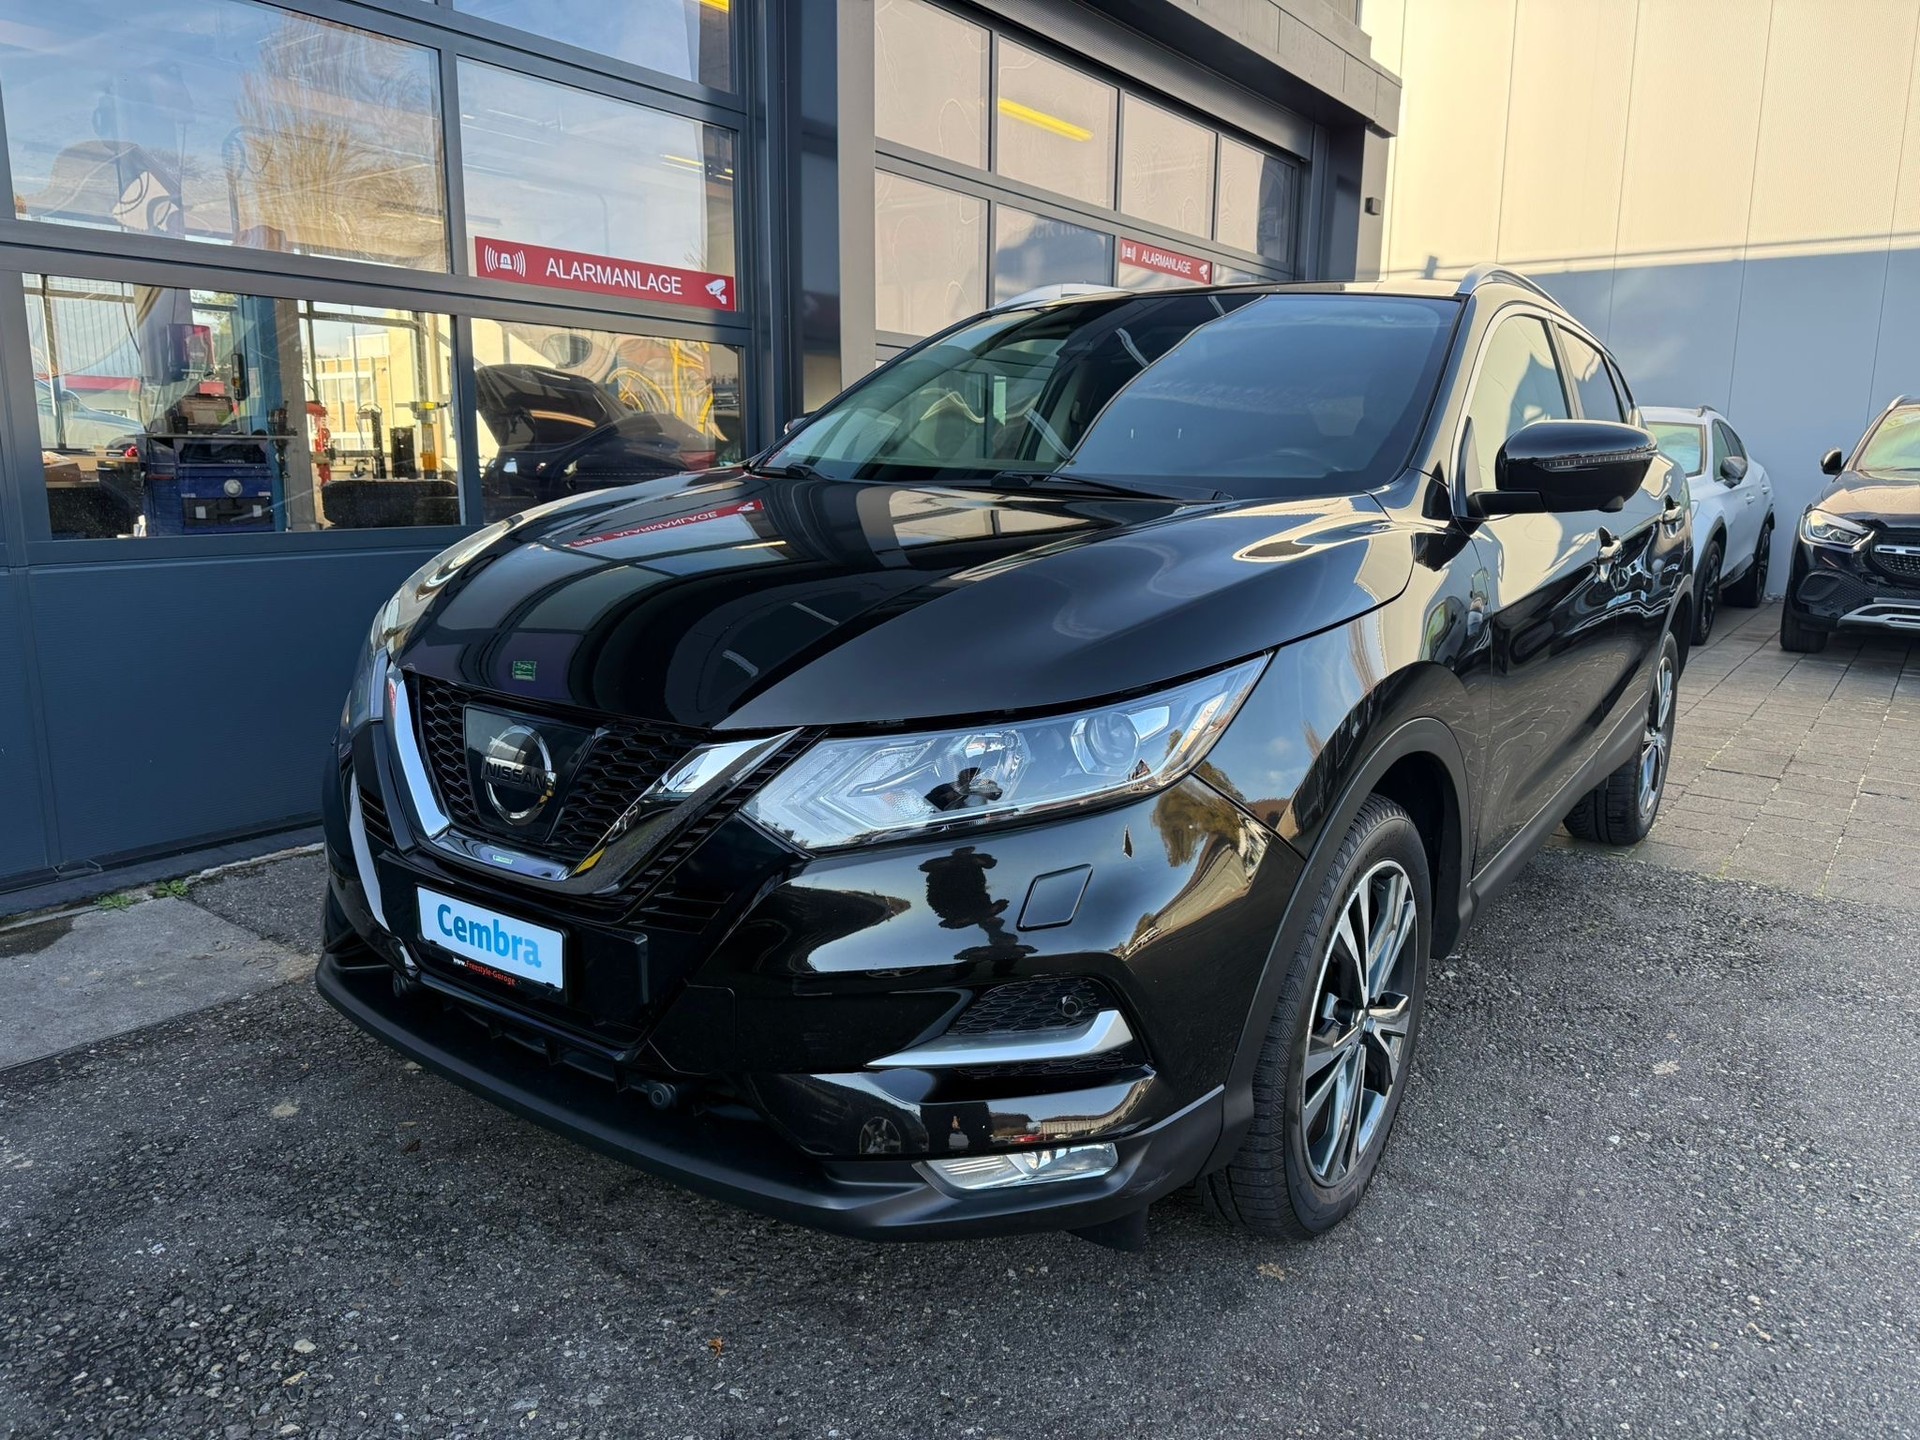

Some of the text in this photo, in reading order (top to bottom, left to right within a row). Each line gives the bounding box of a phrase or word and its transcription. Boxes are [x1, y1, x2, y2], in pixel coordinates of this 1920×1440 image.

[545, 257, 683, 296] ALARMANLAGE
[1141, 250, 1191, 275] ALARMANLAGE
[484, 761, 547, 792] NISSAN
[437, 903, 542, 969] Cembra
